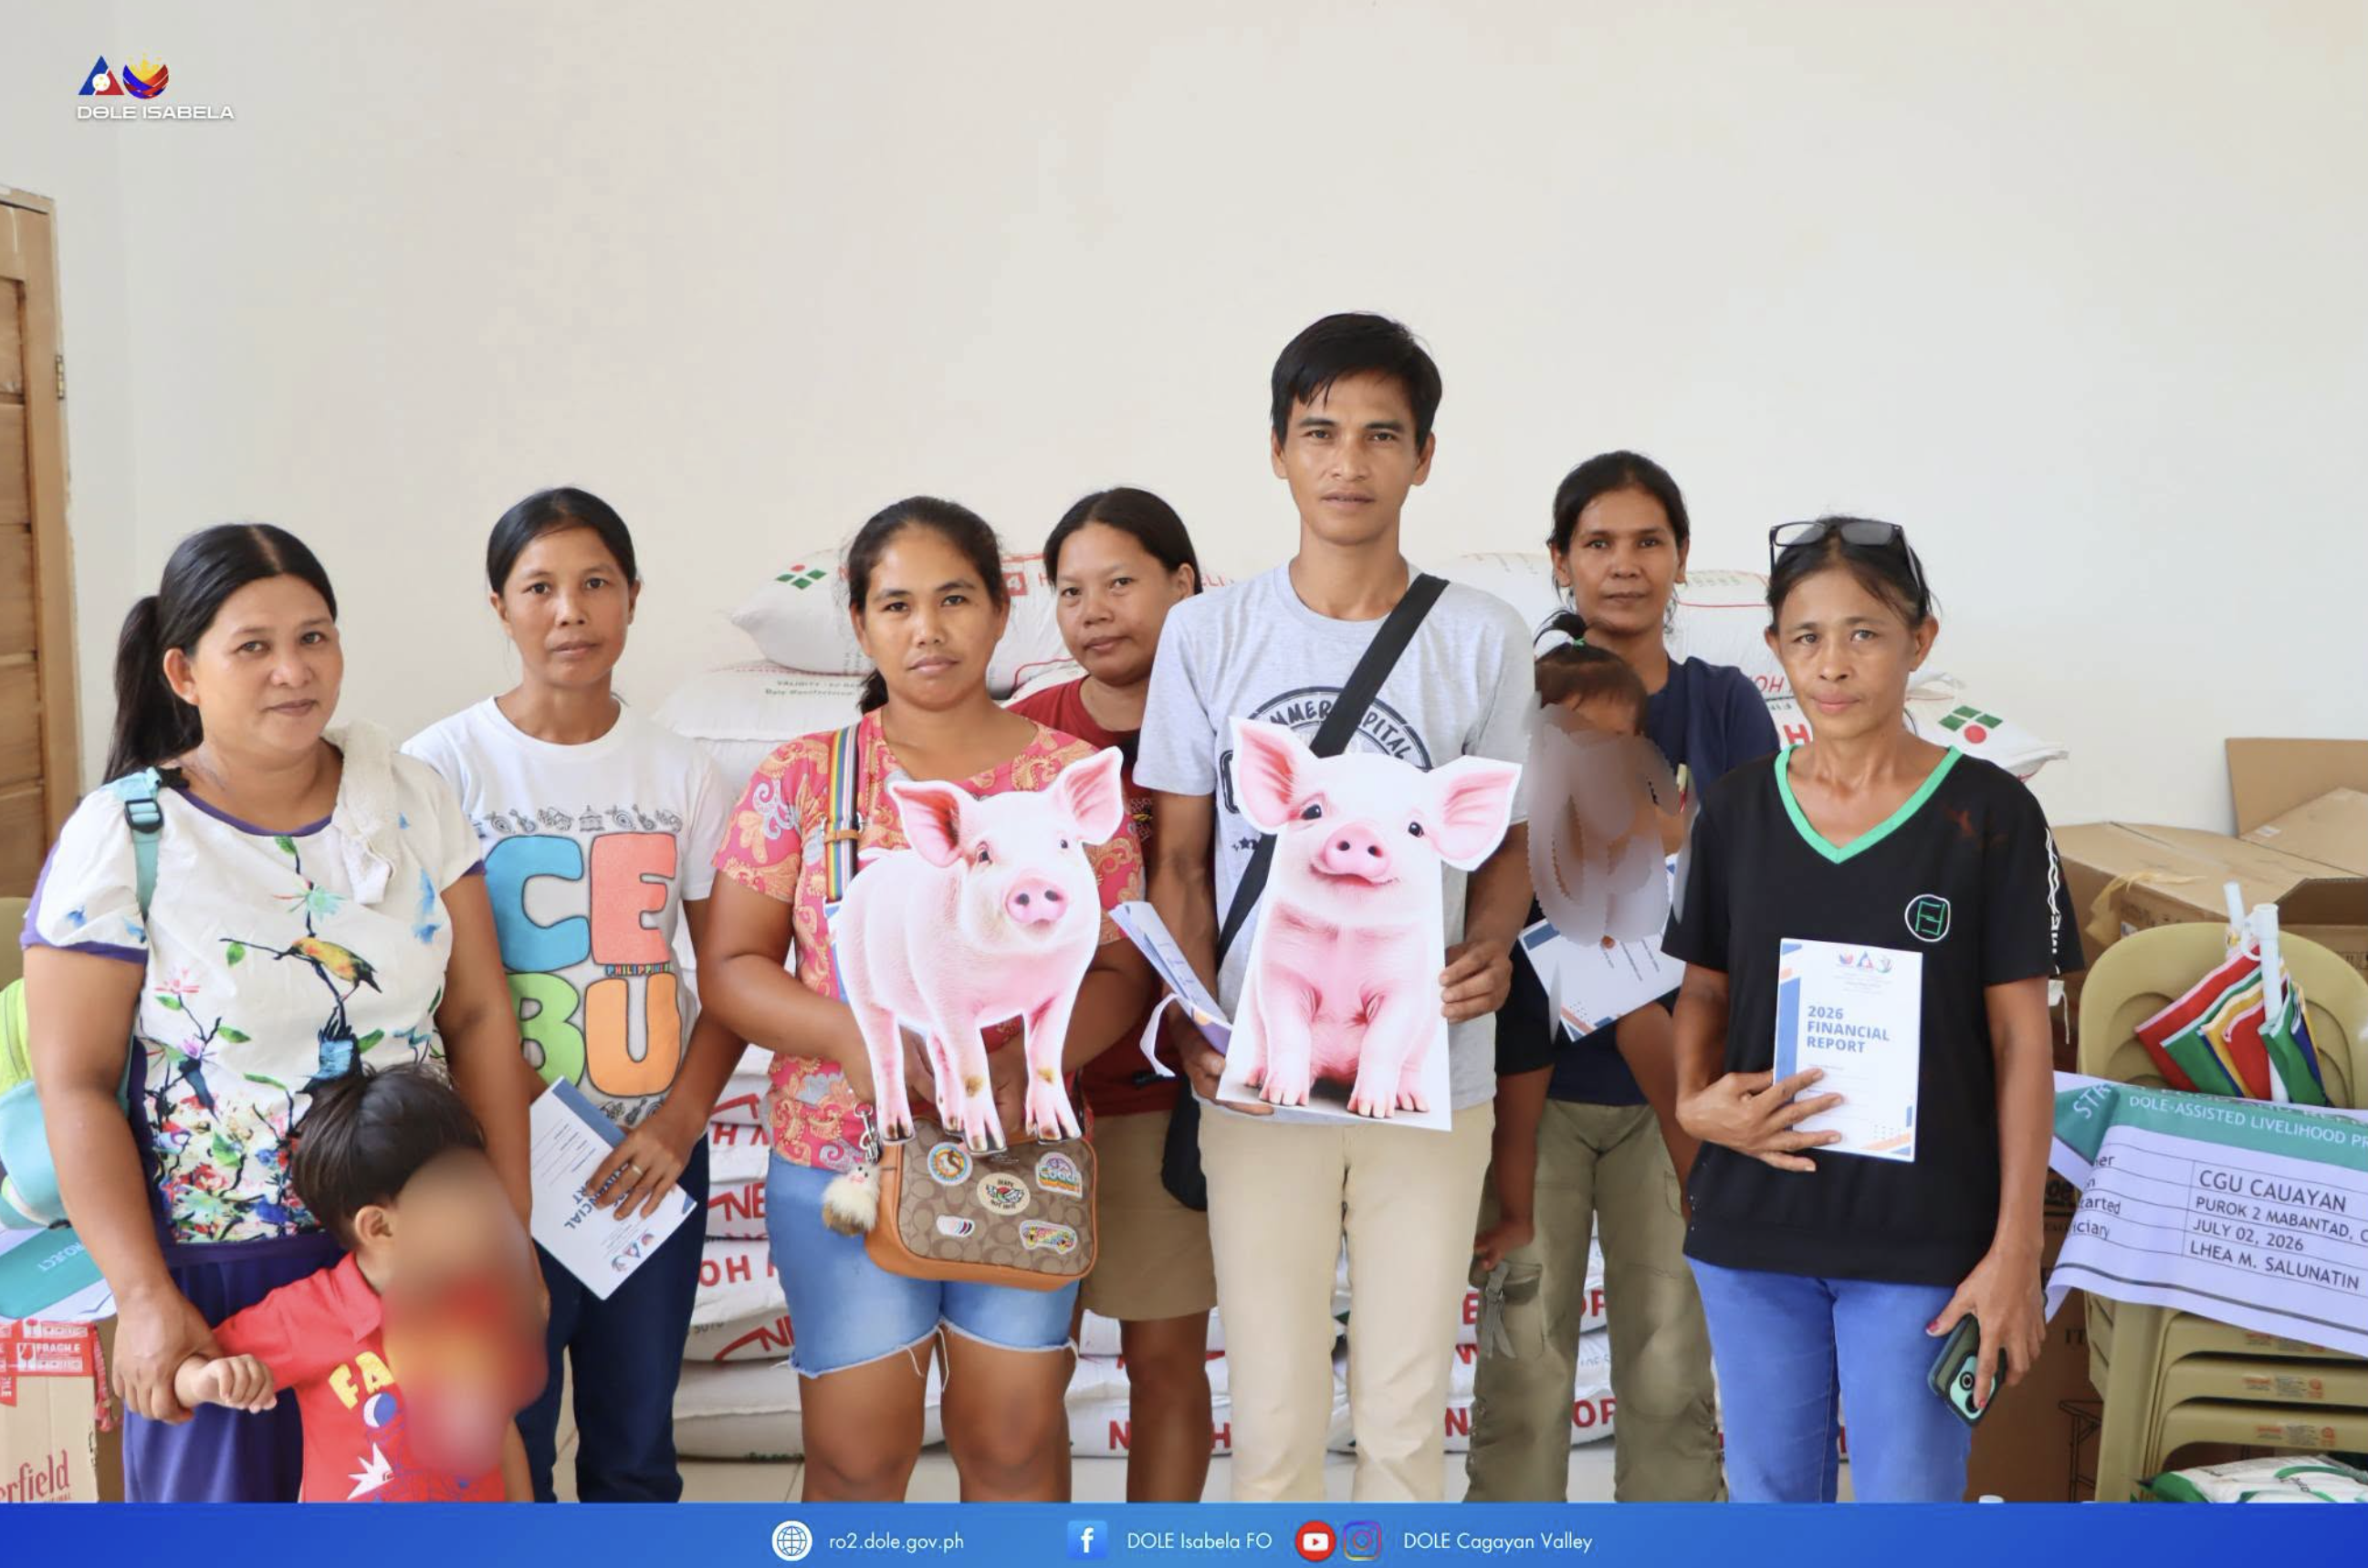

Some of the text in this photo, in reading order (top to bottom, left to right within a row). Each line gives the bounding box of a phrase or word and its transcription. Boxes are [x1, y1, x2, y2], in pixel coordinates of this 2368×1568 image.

[1362, 711, 1411, 759] PITAL
[1807, 1005, 1843, 1019] 2026
[1807, 1020, 1890, 1041] FINANCIAL
[1807, 1036, 1865, 1053] REPORT
[2130, 1096, 2246, 1126] DOLE-ASSISTED
[2251, 1116, 2345, 1144] LIVELIHOOD
[2196, 1197, 2247, 1218] PUROK
[2252, 1207, 2261, 1220] 2
[2199, 1169, 2346, 1213] CGU CAUAYAN
[2193, 1219, 2304, 1251] JULY 02, 2026
[2190, 1240, 2360, 1291] LHEA M. SALUNATIN
[329, 1351, 394, 1410] FA
